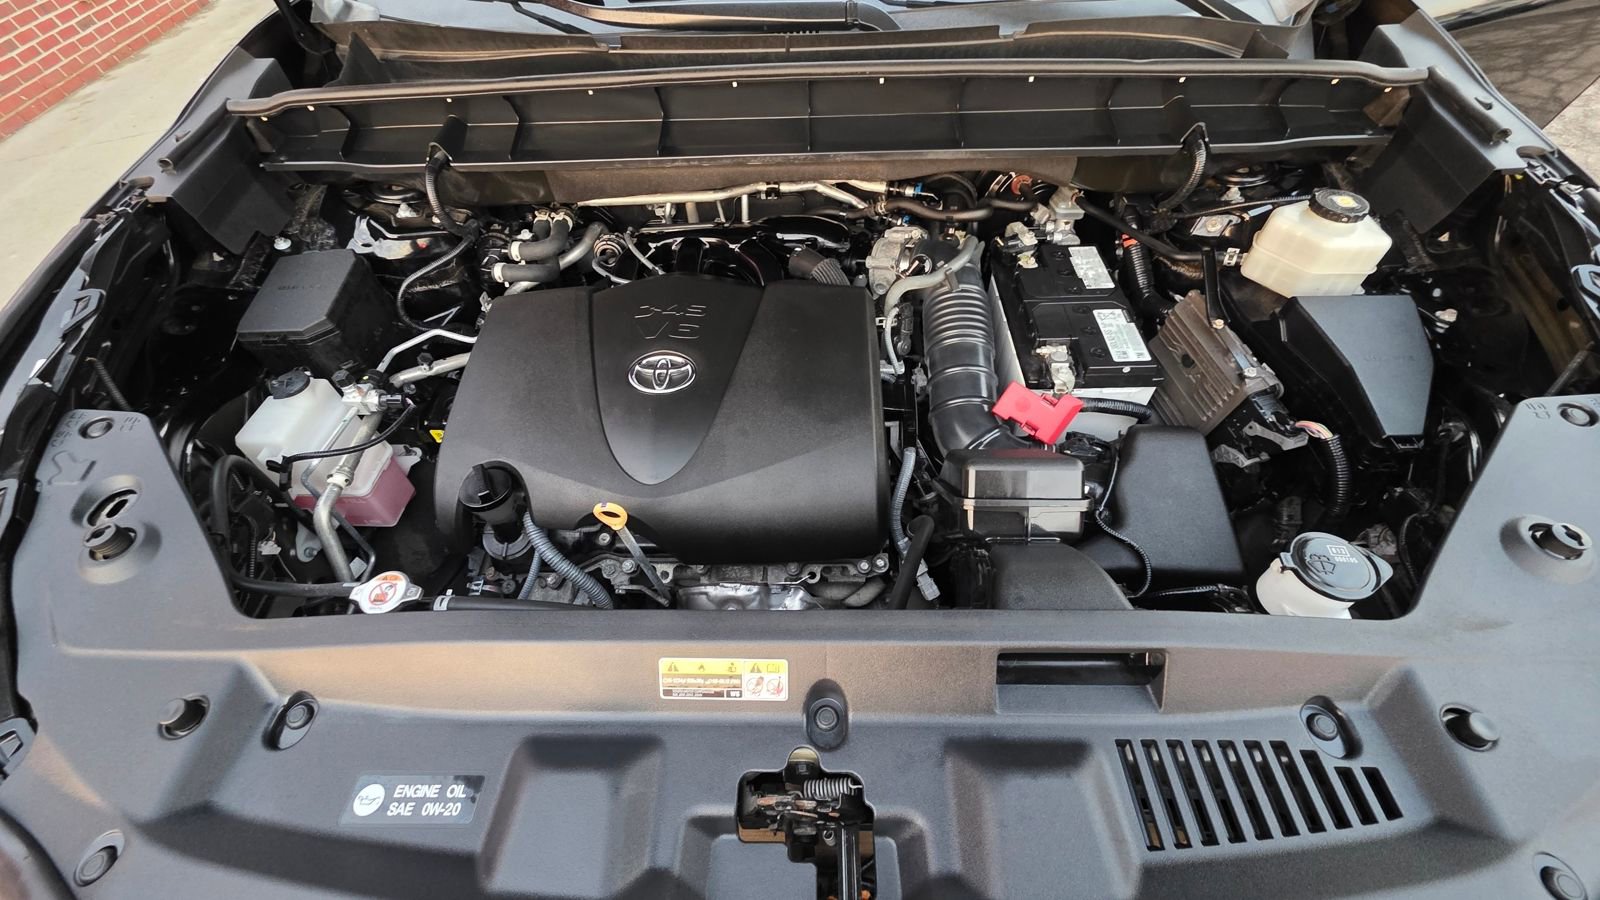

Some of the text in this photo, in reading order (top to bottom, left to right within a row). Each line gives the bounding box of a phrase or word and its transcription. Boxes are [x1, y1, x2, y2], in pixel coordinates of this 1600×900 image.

[393, 784, 467, 798] ENGINE OIL
[387, 802, 462, 816] SAE 0W-20
